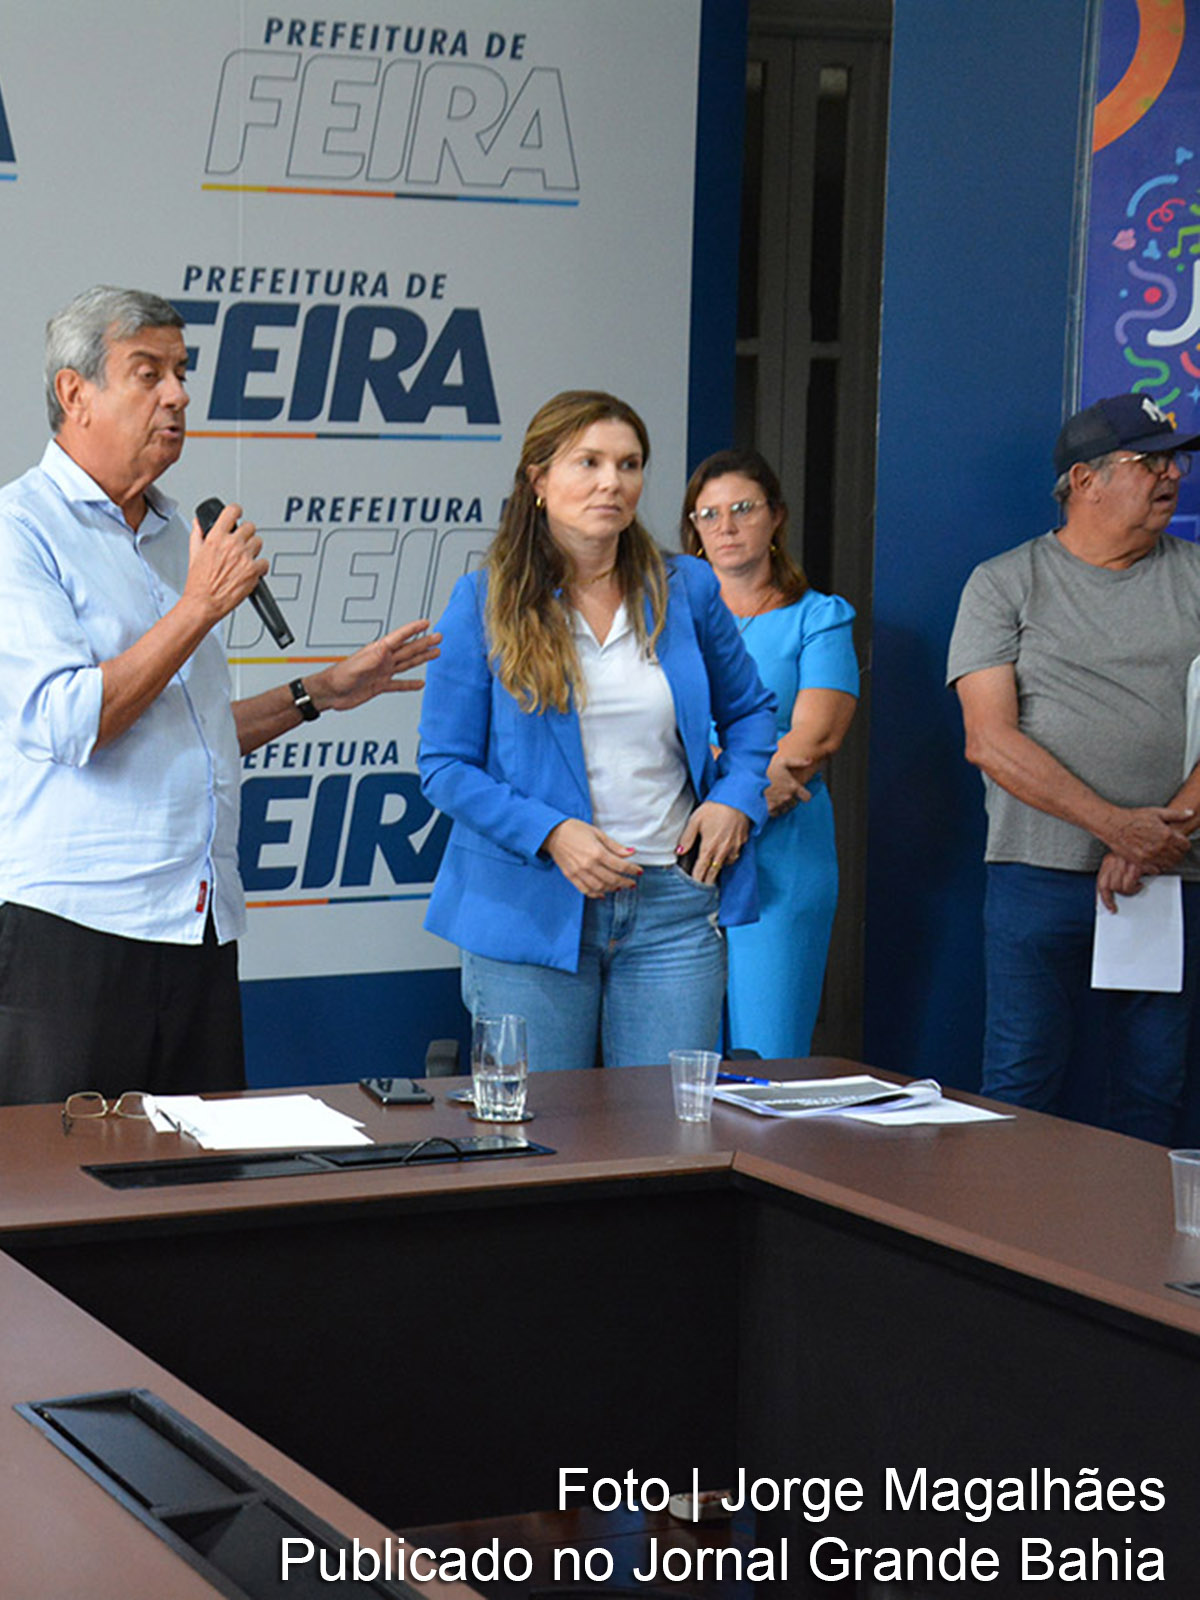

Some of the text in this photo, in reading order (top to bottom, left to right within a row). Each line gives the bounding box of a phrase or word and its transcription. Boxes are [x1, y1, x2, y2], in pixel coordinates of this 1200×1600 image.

[263, 17, 527, 61] PREFEITURA DE
[204, 48, 580, 191] FEIRA
[182, 264, 447, 300] PREFEITURA DE
[284, 496, 483, 523] PREFEITURA
